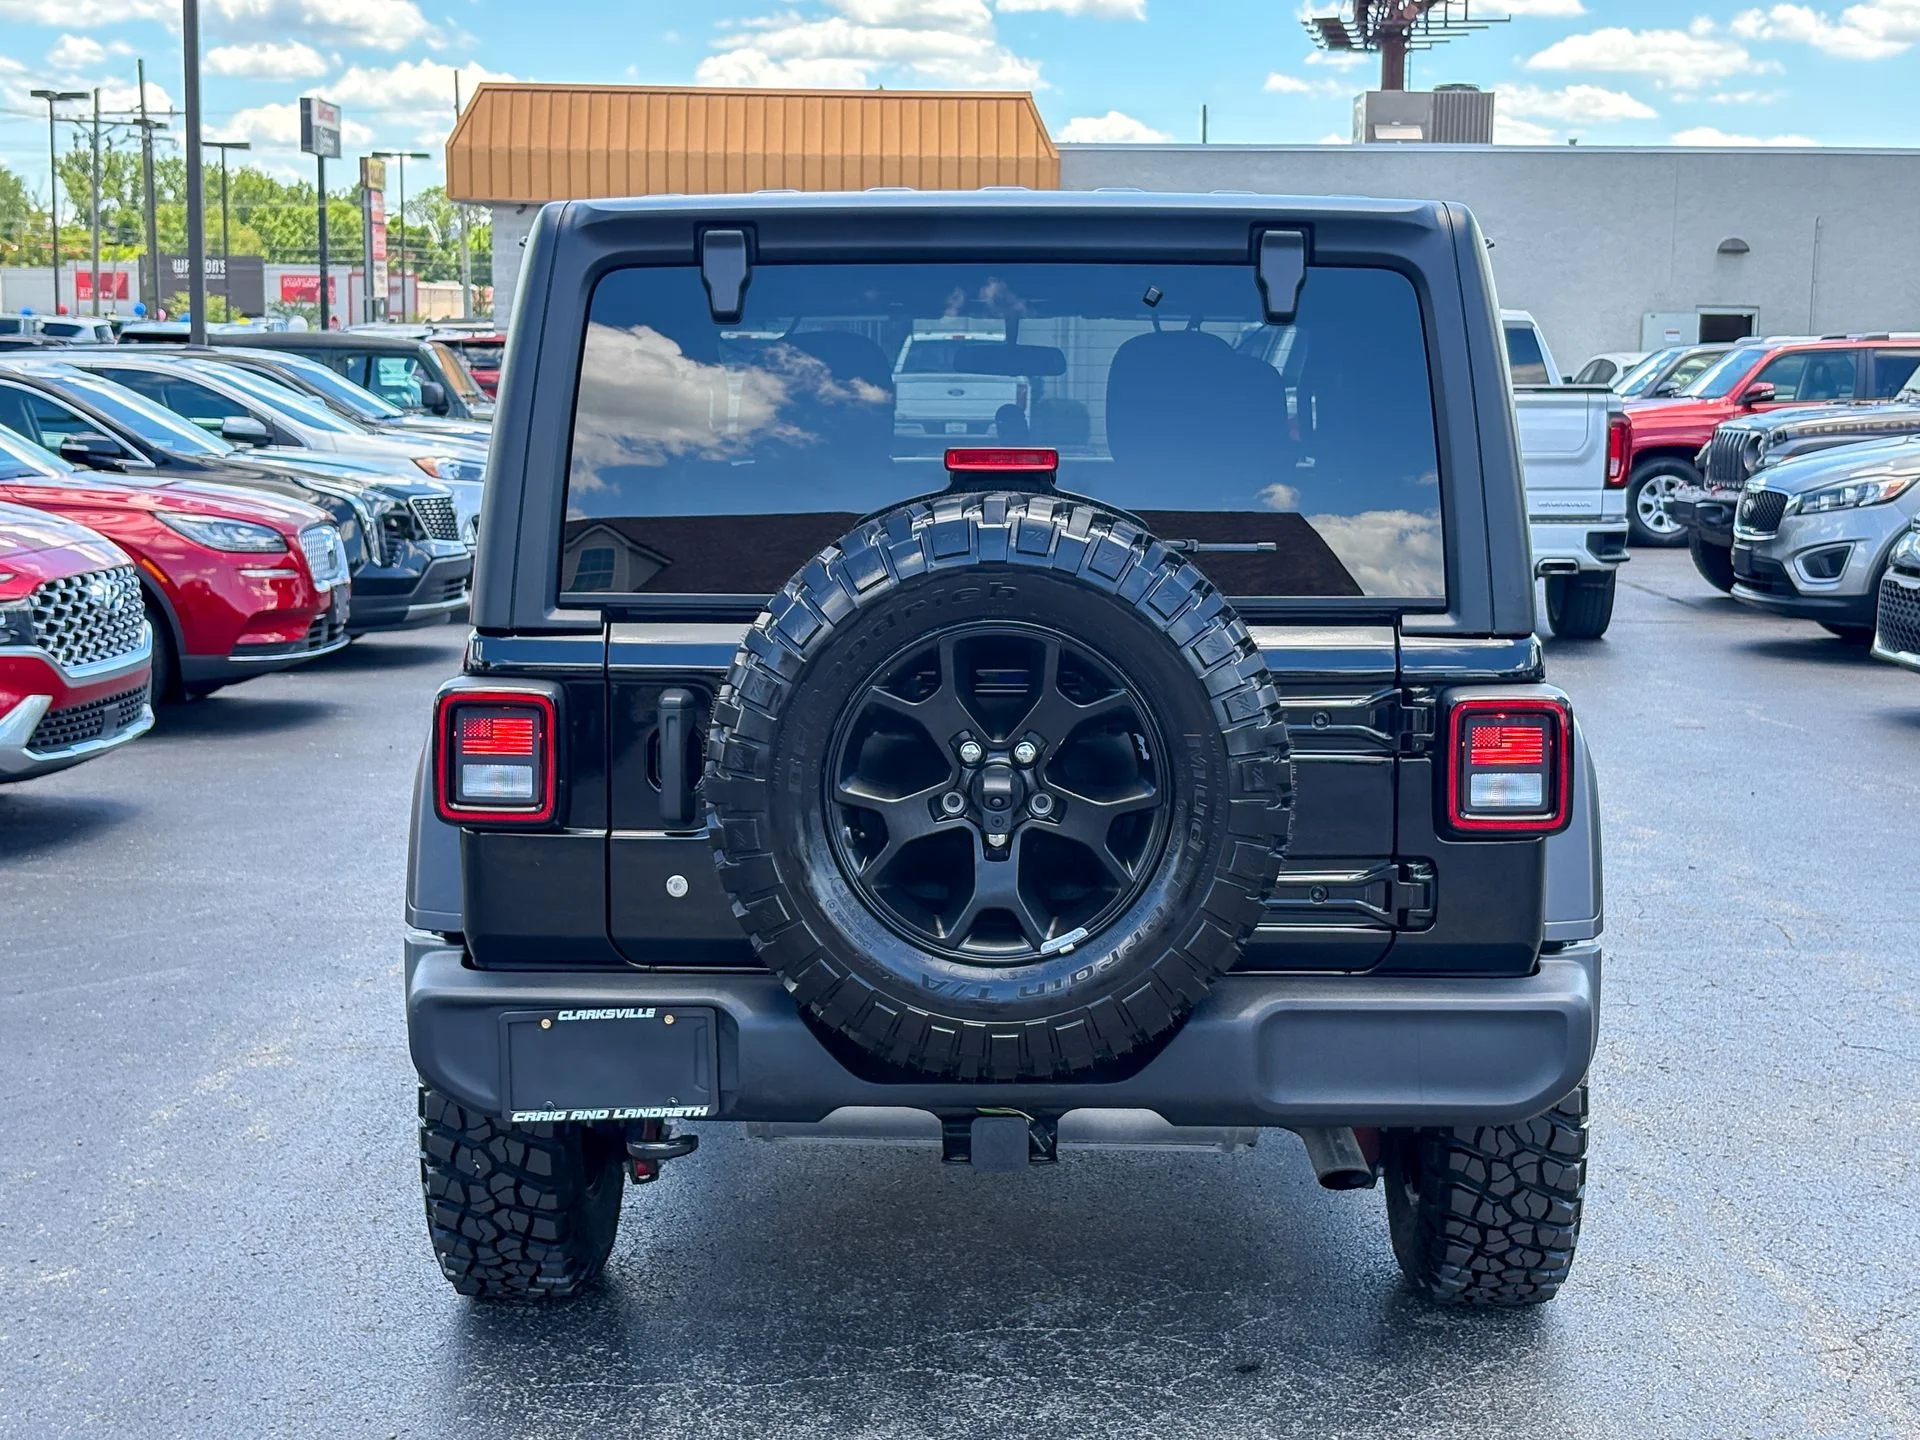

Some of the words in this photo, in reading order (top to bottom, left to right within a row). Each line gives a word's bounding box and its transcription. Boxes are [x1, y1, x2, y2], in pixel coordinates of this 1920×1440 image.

[557, 1007, 656, 1020] CLARKSVILLE
[511, 1110, 567, 1123] CRAIG
[569, 1109, 610, 1122] AND
[612, 1106, 708, 1120] LANDRETH
